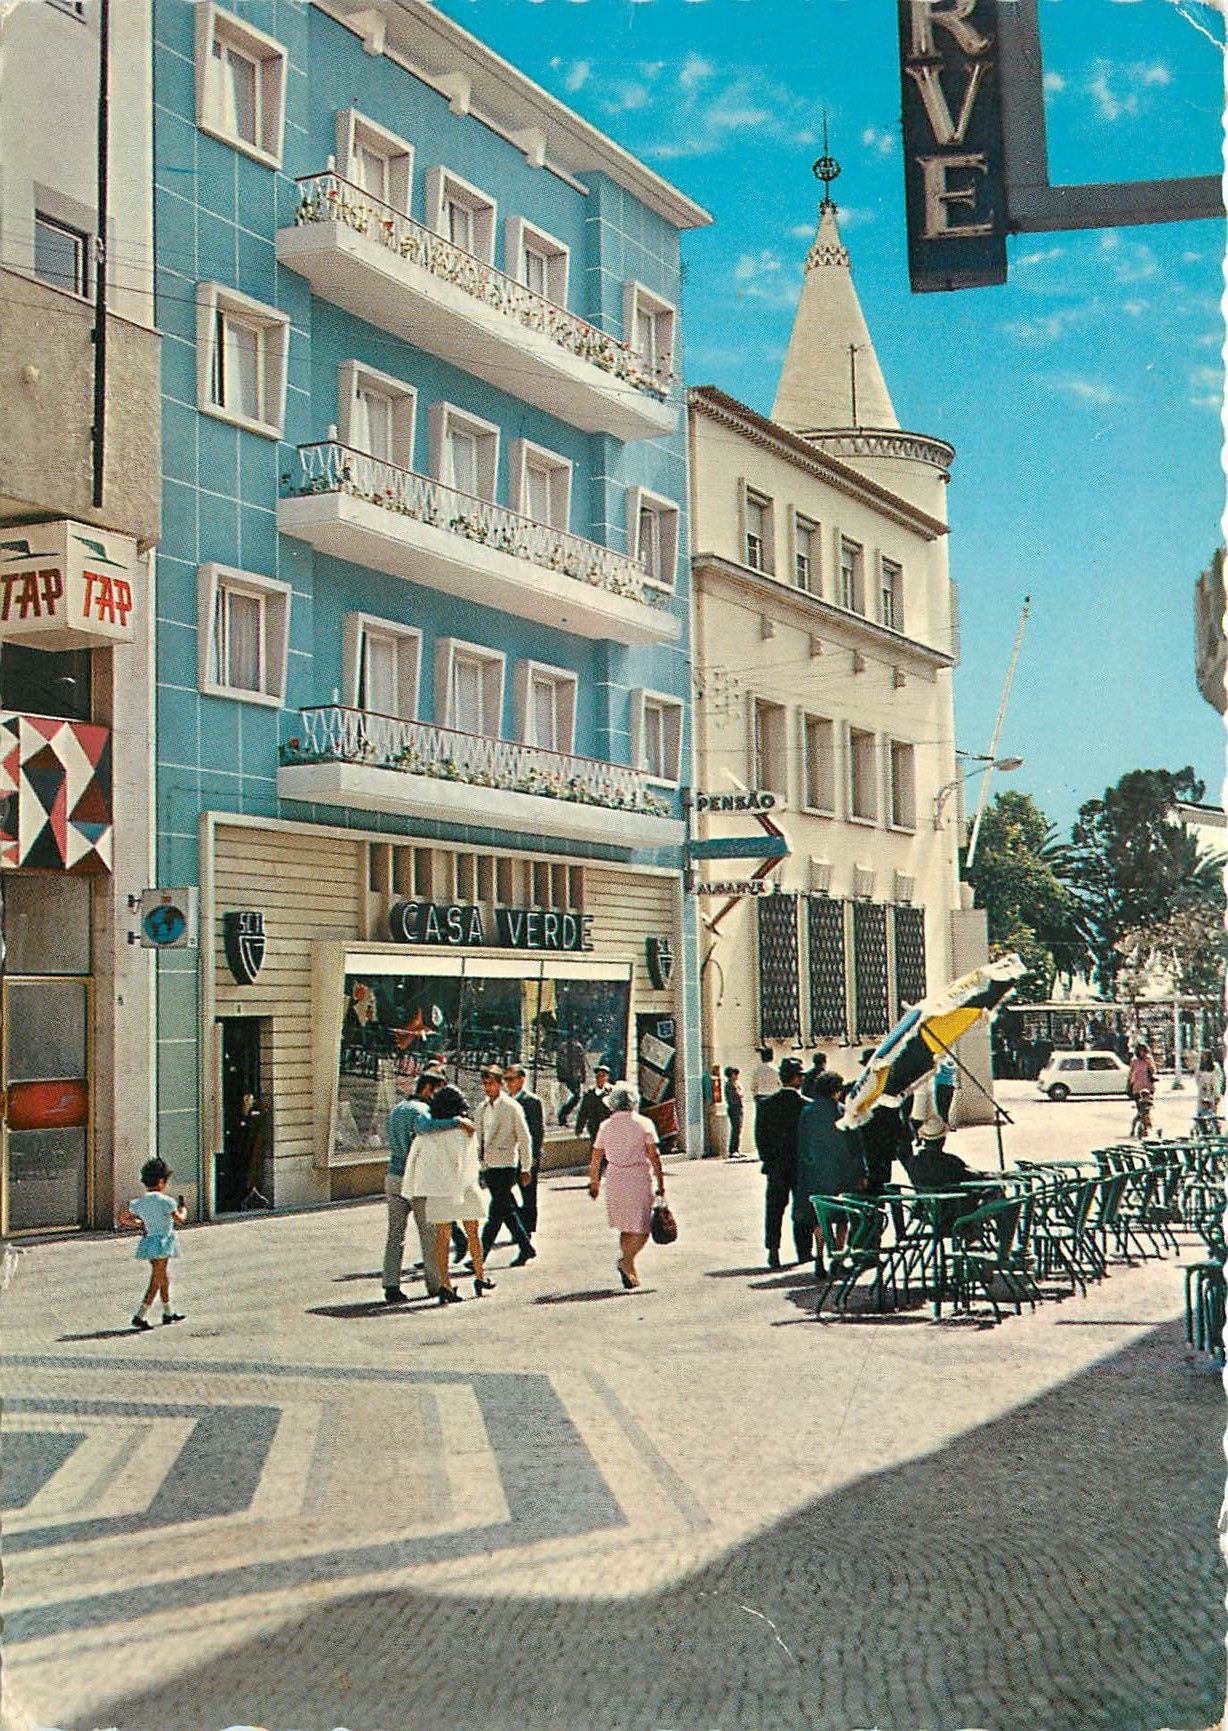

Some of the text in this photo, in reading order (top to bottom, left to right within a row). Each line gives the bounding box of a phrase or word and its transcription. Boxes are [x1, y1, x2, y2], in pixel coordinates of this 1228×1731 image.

[1, 568, 63, 621] TAP
[82, 570, 133, 627] TAP
[697, 790, 776, 812] PENSÃO
[399, 902, 595, 951] CASA VERDE
